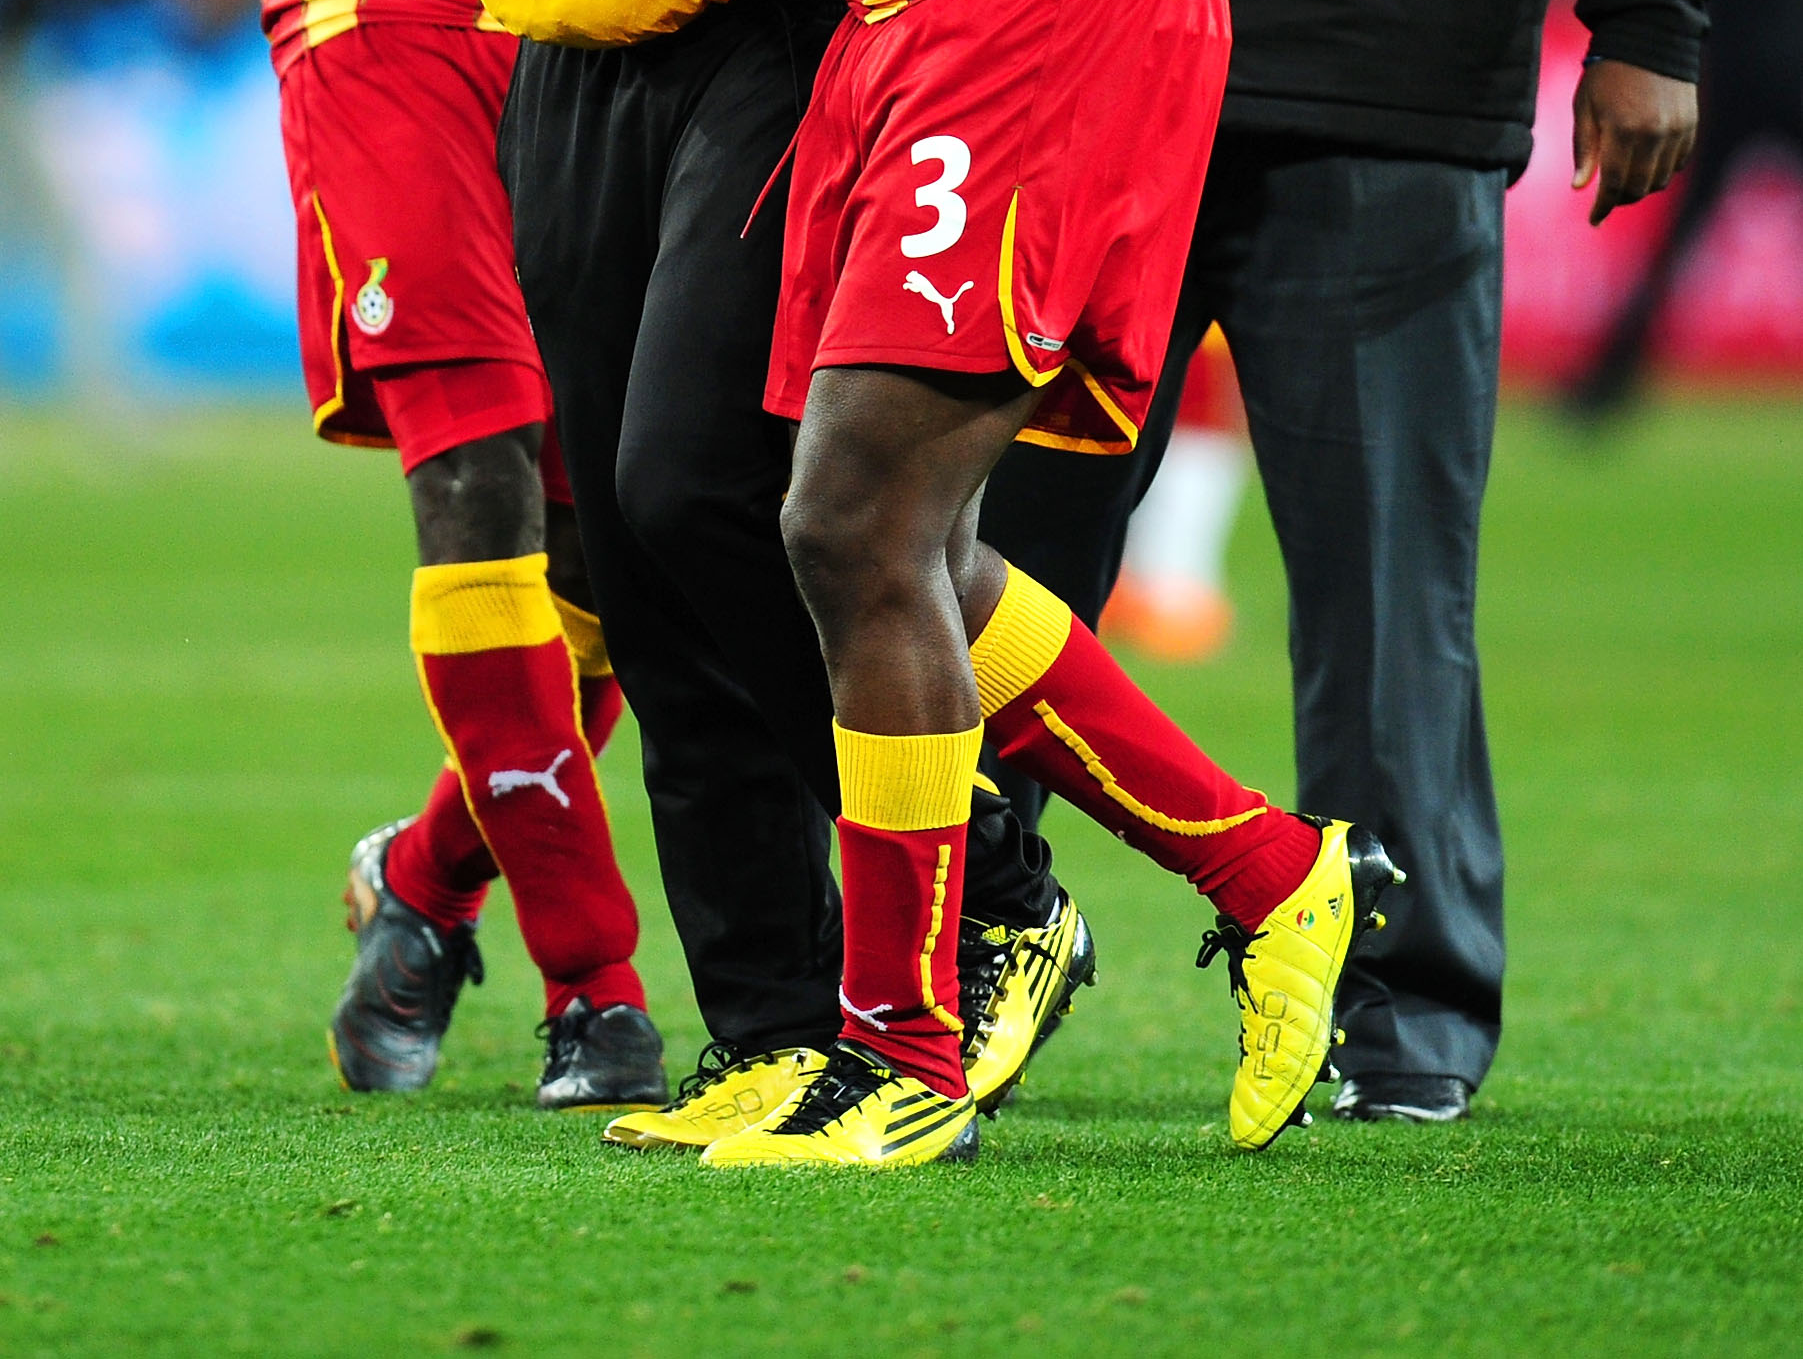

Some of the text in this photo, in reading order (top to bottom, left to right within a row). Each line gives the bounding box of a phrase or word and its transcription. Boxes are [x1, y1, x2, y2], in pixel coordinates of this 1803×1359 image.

[901, 135, 971, 258] 3
[1254, 991, 1289, 1079] F50
[683, 1087, 763, 1127] F50
